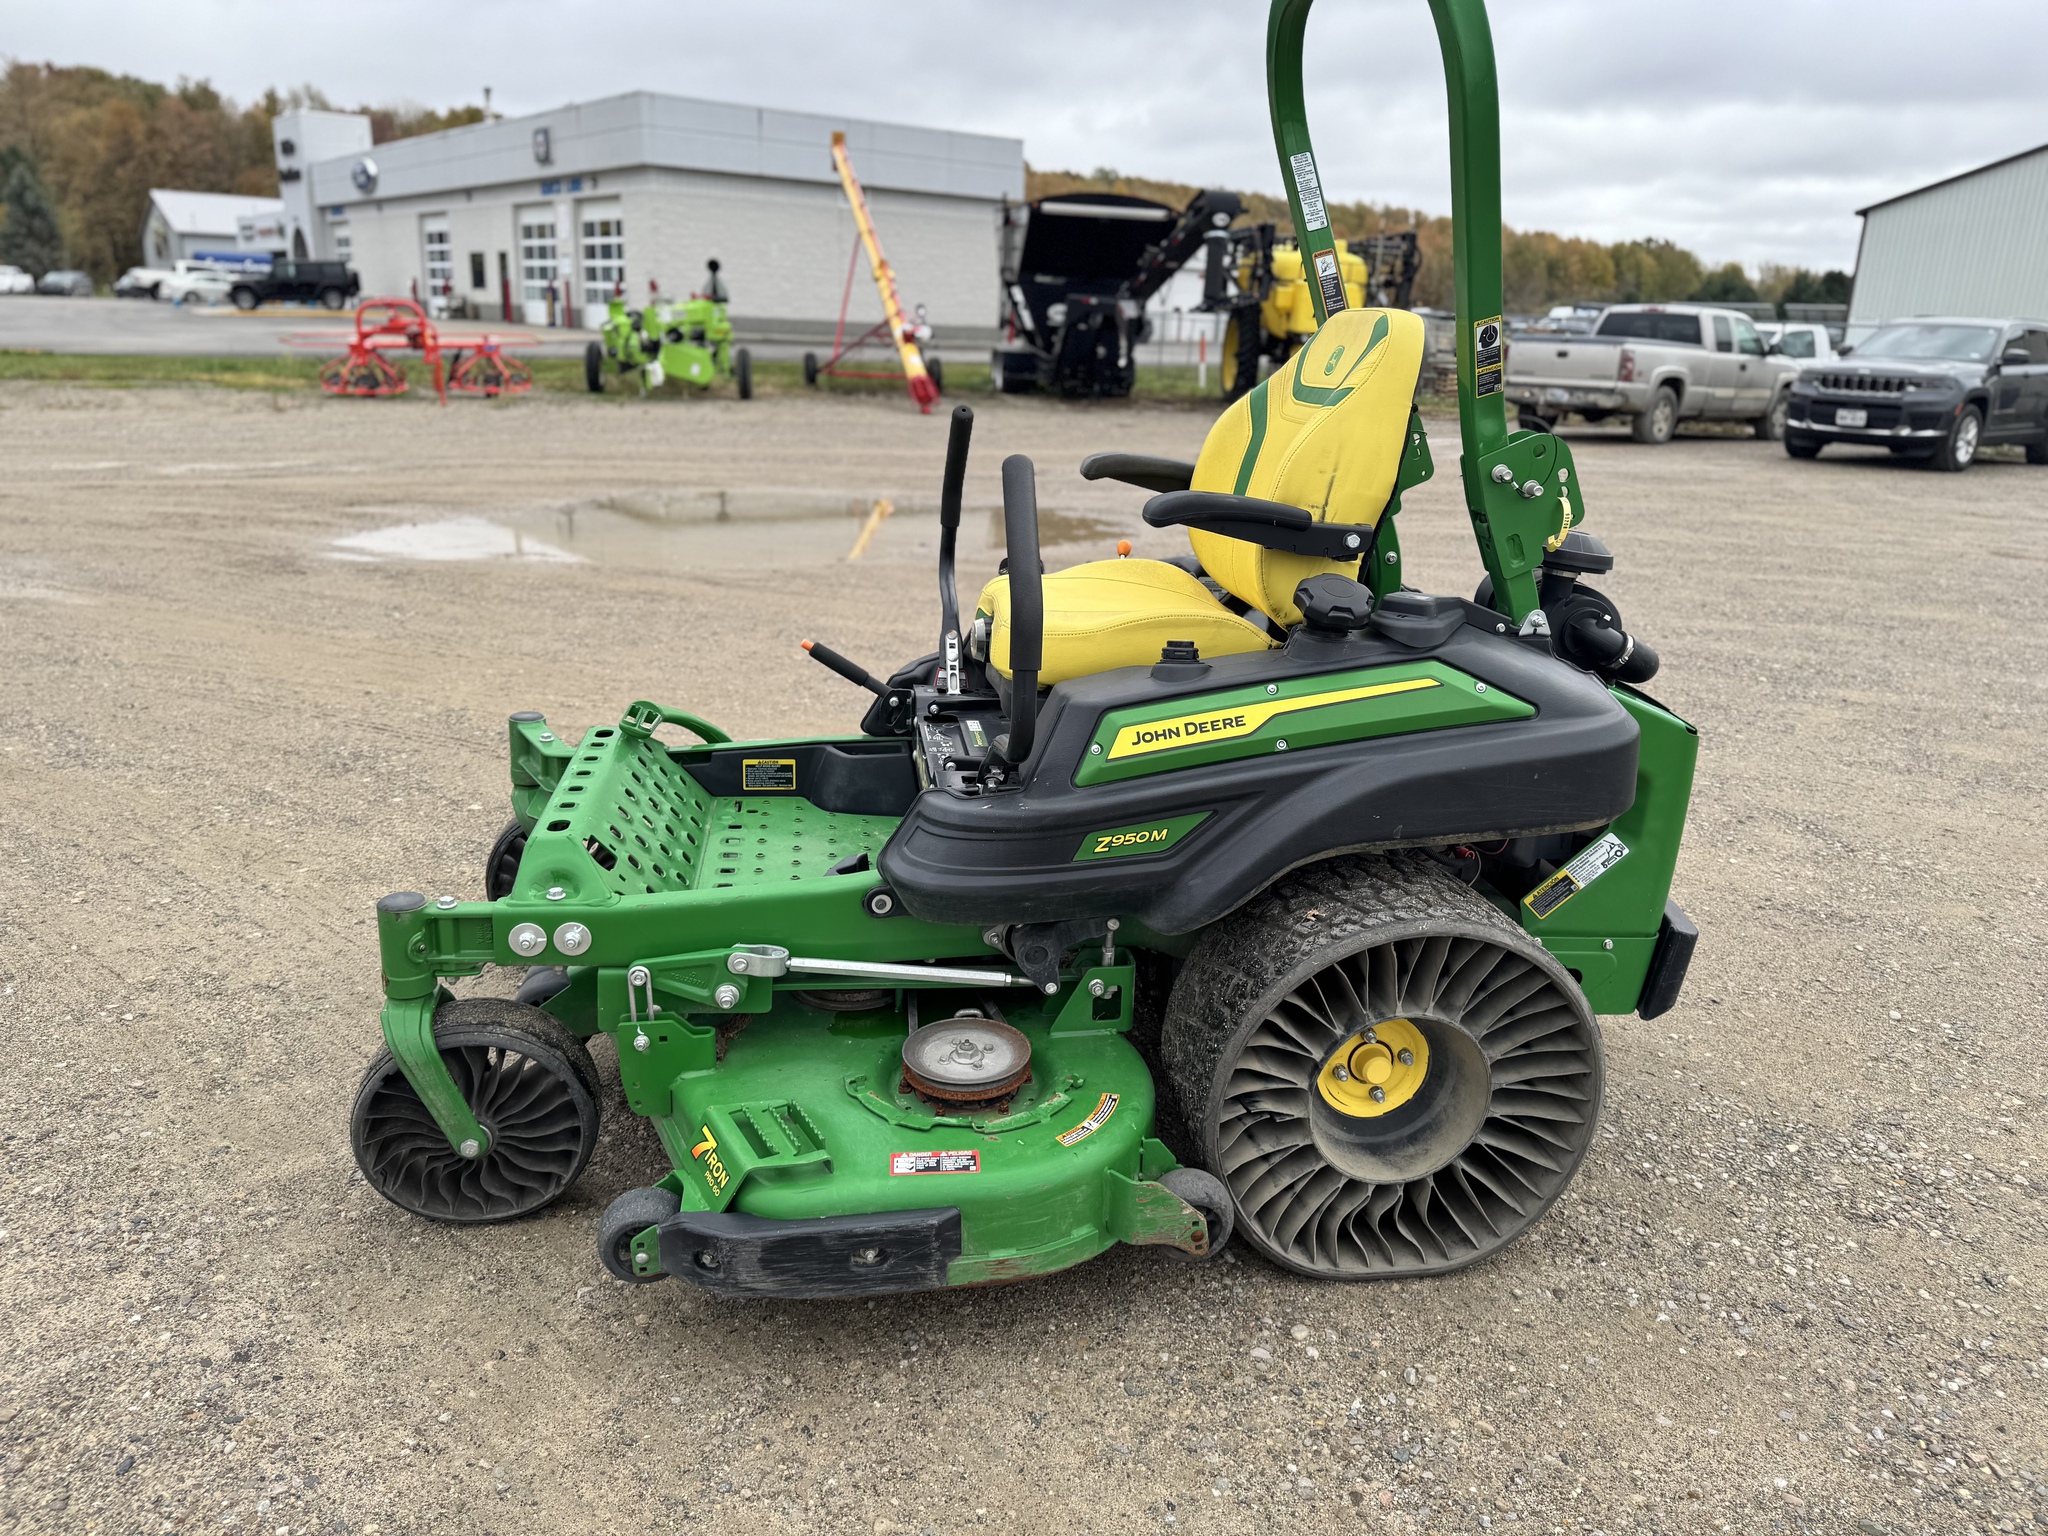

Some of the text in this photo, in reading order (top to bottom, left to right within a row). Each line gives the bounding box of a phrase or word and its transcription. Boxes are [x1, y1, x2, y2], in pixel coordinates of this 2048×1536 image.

[1132, 716, 1246, 746] JOHN DEERE
[1093, 829, 1168, 853] Z950M
[704, 1170, 721, 1197] PRO 60
